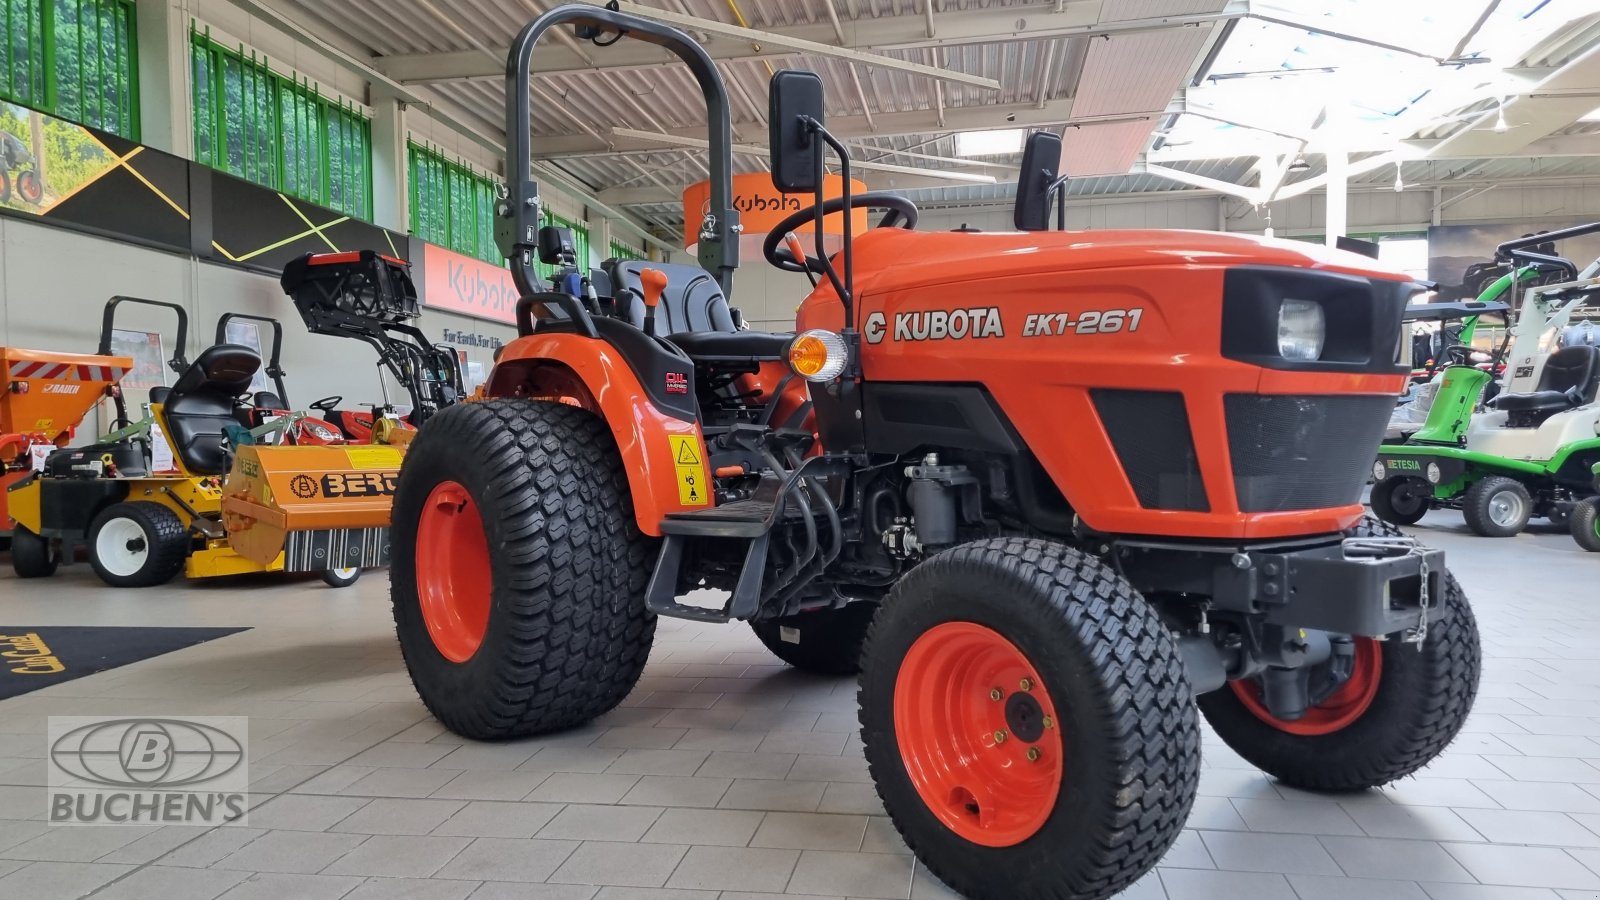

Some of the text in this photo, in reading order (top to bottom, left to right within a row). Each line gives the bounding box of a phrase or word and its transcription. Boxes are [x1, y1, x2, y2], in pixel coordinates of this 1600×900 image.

[733, 193, 801, 212] Kubota
[894, 307, 1144, 342] KUBOTA EK1-261
[443, 328, 456, 343] For
[666, 372, 688, 383] OIL
[52, 384, 80, 394] RAUCH
[1391, 459, 1421, 470] ETESIA
